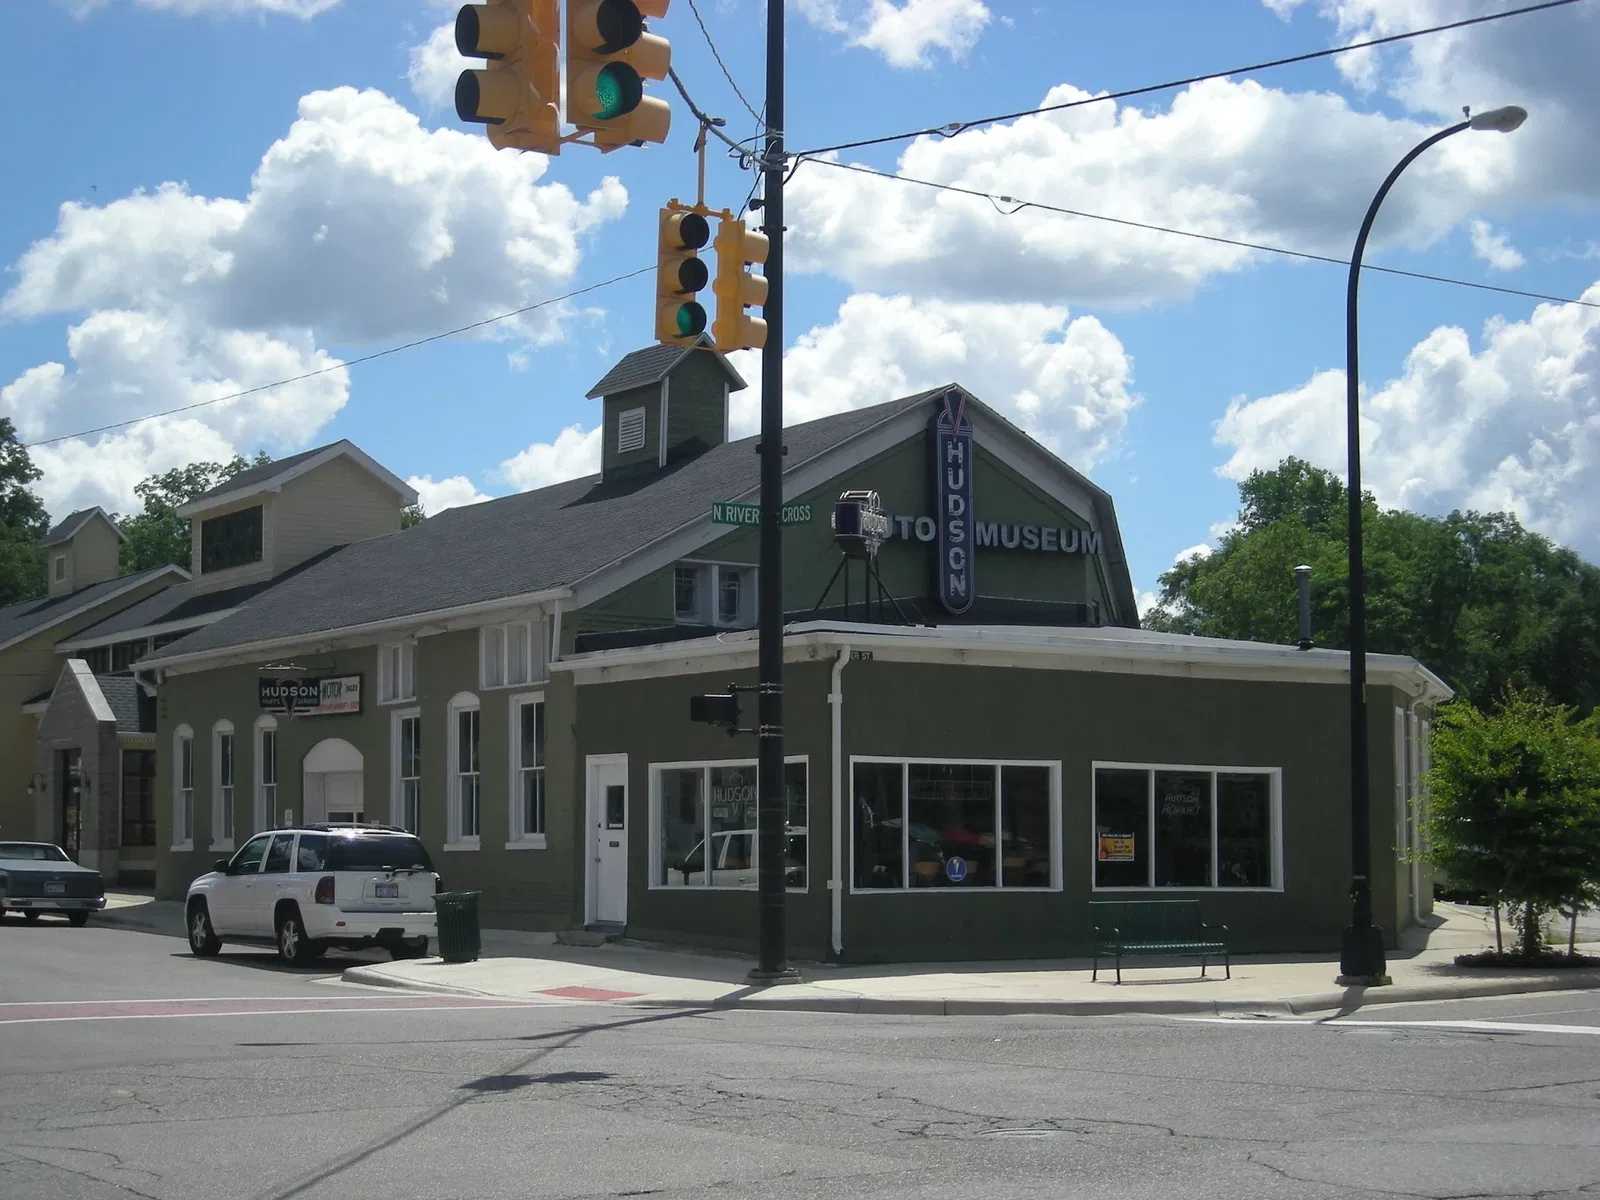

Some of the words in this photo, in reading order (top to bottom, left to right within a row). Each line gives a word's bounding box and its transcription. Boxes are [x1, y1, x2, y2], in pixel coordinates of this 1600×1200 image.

[726, 506, 760, 525] RIVER
[782, 505, 811, 523] CROSS
[946, 440, 967, 597] HUDSON
[975, 520, 1102, 555] MUSEUM
[261, 686, 318, 697] HUDSON
